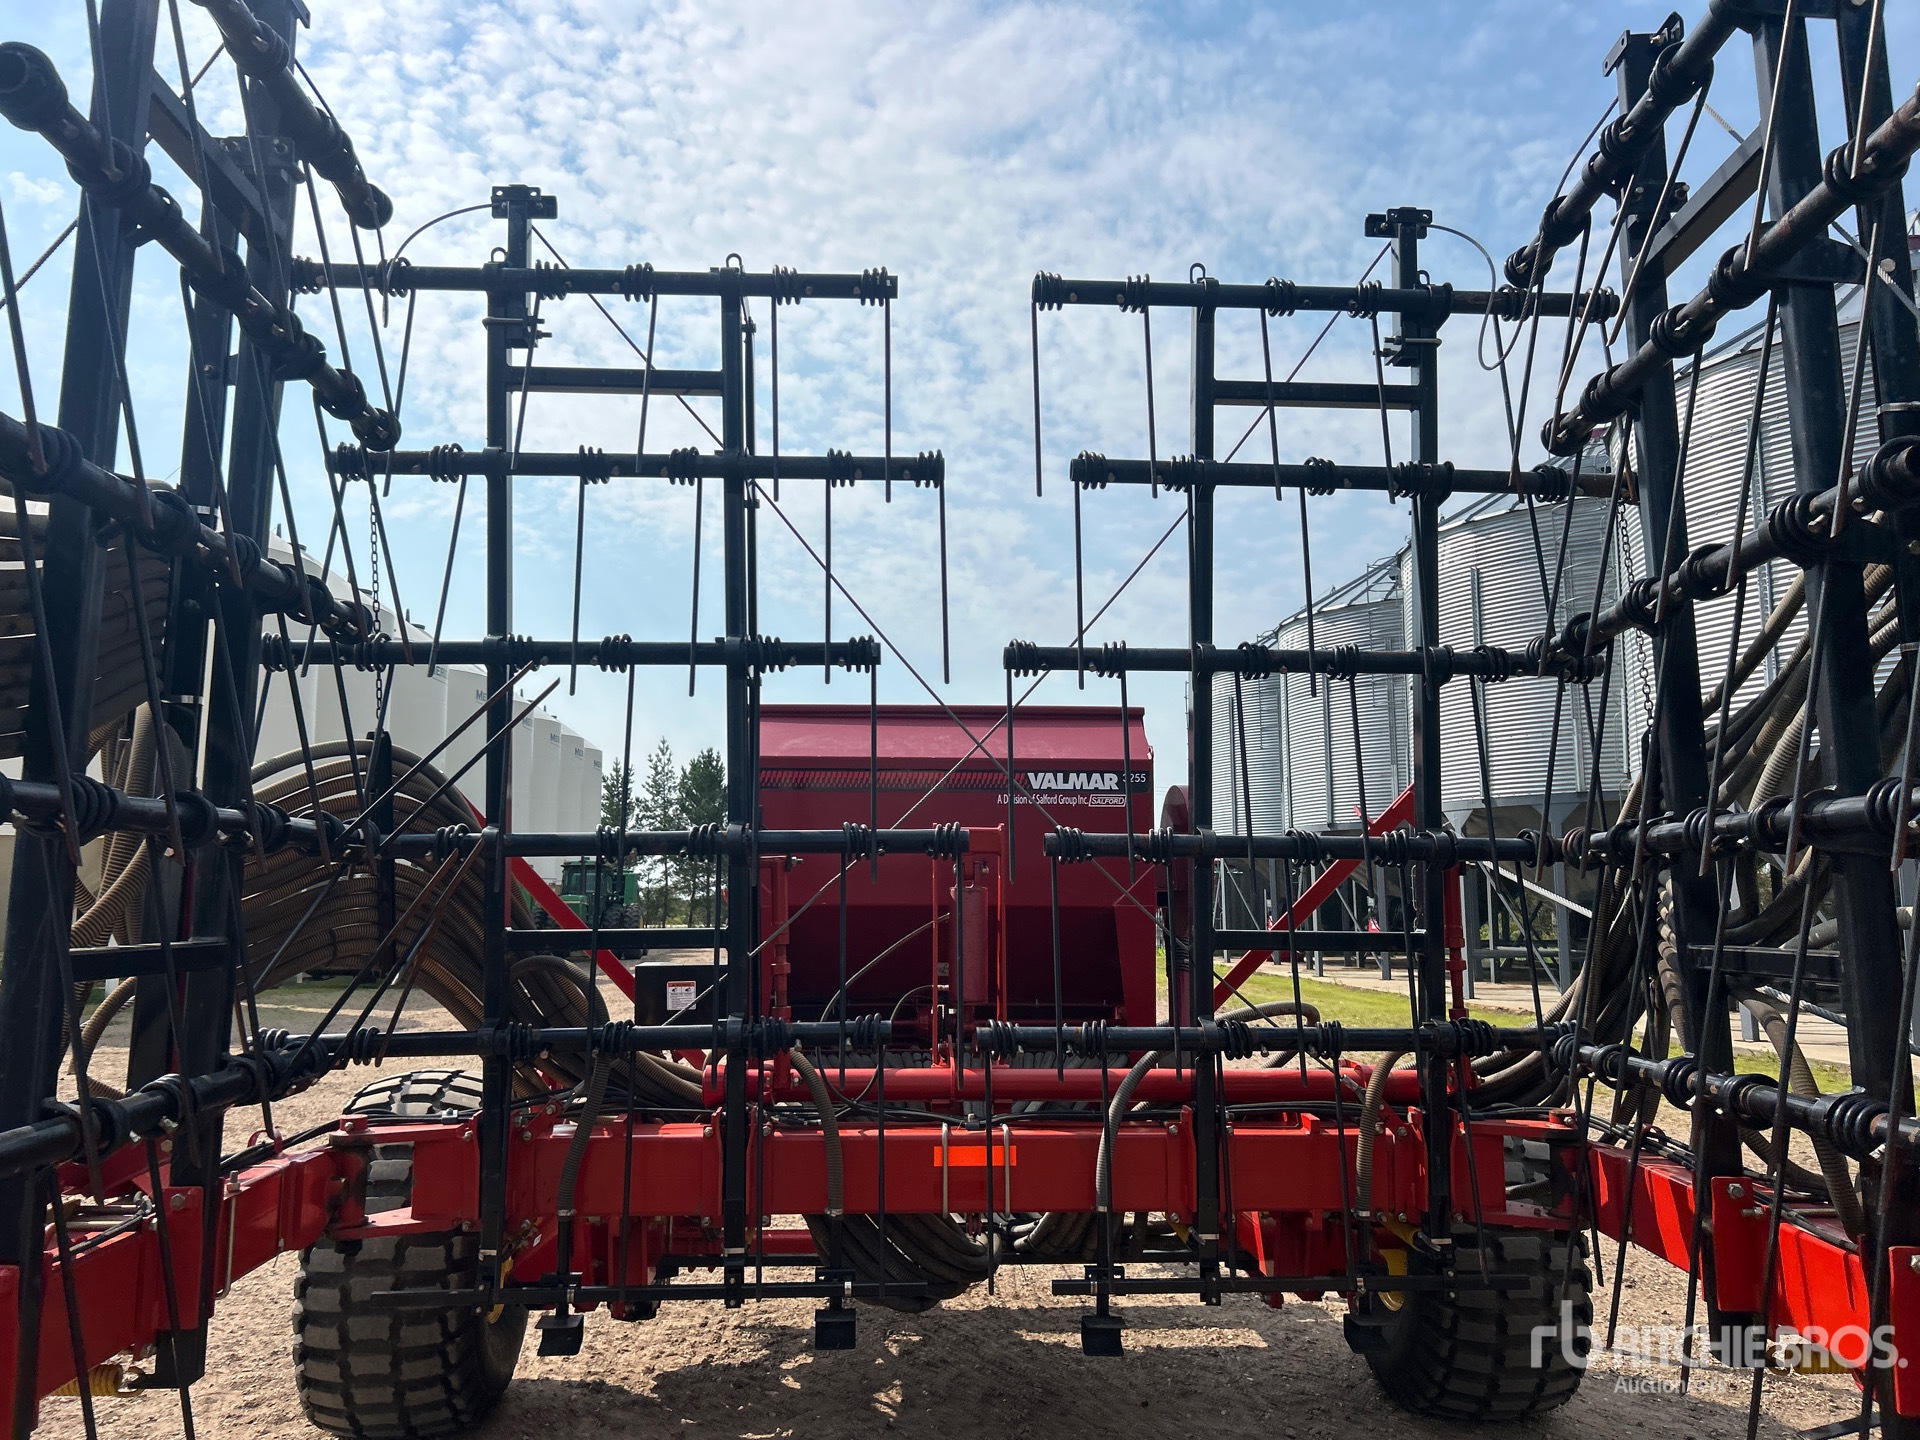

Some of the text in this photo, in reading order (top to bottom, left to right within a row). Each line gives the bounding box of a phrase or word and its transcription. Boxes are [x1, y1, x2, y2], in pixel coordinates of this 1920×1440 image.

[1027, 772, 1119, 790] VALMAR
[997, 793, 1003, 805] A
[1003, 793, 1028, 805] Dision
[1036, 793, 1058, 805] Salford
[1058, 794, 1077, 807] Group
[1078, 794, 1089, 805] Inc.
[1091, 796, 1125, 805] SALFORD
